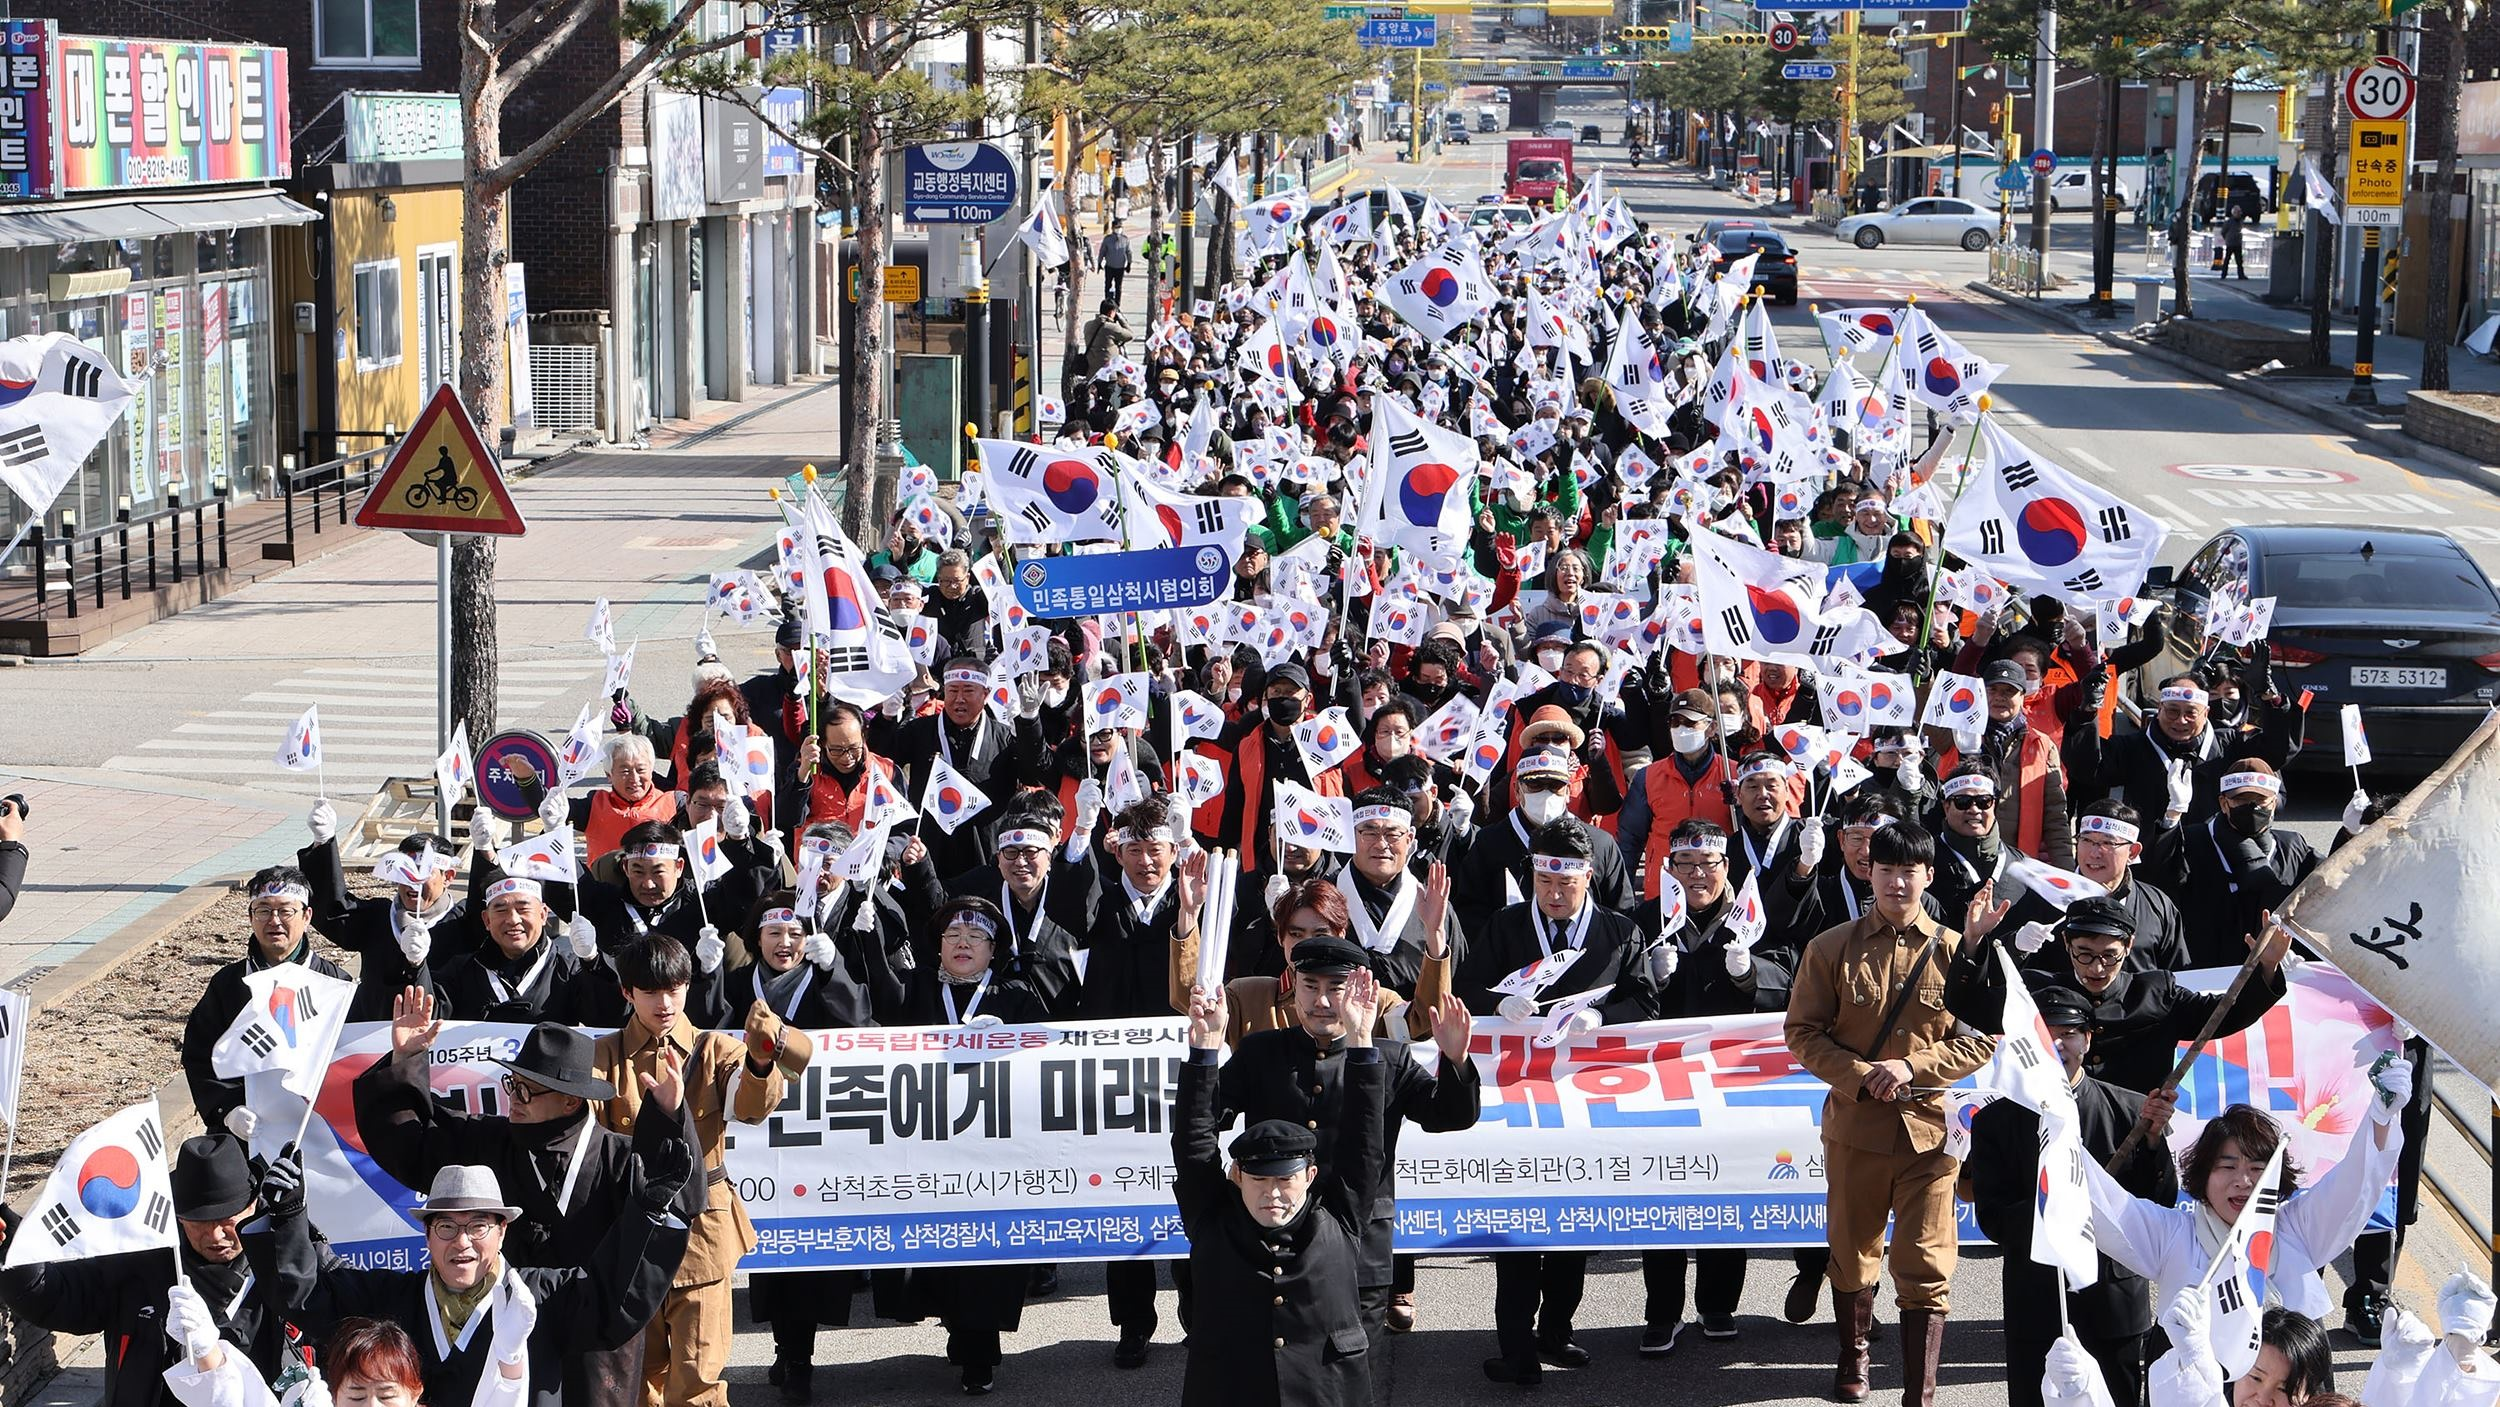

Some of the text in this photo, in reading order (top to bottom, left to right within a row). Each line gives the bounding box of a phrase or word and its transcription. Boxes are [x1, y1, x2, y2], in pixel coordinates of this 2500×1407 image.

[1378, 22, 1410, 35] 중앙로
[1775, 30, 1791, 44] 30
[0, 56, 39, 88] 폰
[64, 49, 265, 147] 대폰할인마트
[2360, 75, 2401, 106] 30
[126, 157, 190, 181] 010-8218-4145
[2356, 159, 2397, 174] 단속중
[913, 172, 1007, 193] 교동행정복지센터
[2352, 189, 2398, 198] enforcement
[2359, 178, 2392, 188] Photo
[913, 193, 938, 201] Gyo-dong
[939, 193, 967, 201] Community
[952, 205, 991, 220] 100m
[2357, 210, 2390, 223] 100m
[2188, 467, 2328, 479] 30
[2187, 488, 2454, 515] 어린이
[1032, 575, 1216, 613] 민족통일삼척시협의회
[2360, 669, 2437, 685] 57조 5312
[488, 768, 545, 785] 주차지
[817, 1026, 1188, 1053] 15독립만세운동 재현행사
[428, 1044, 492, 1066] 105주년
[768, 1059, 1012, 1148] 민족에게
[1396, 1152, 1719, 1185] 척문화예술회관(3.1절 기념식)
[817, 1166, 1078, 1203] 삼척초등학교(시가행진)
[1452, 1207, 1551, 1237] 삼척문화원,
[1556, 1204, 1745, 1235] 삼척시안보안체협의회,
[1750, 1204, 1828, 1231] 삼척시새
[901, 1220, 1001, 1250] 삼척경찰서,
[1006, 1217, 1144, 1247] 삼척교육지원청,
